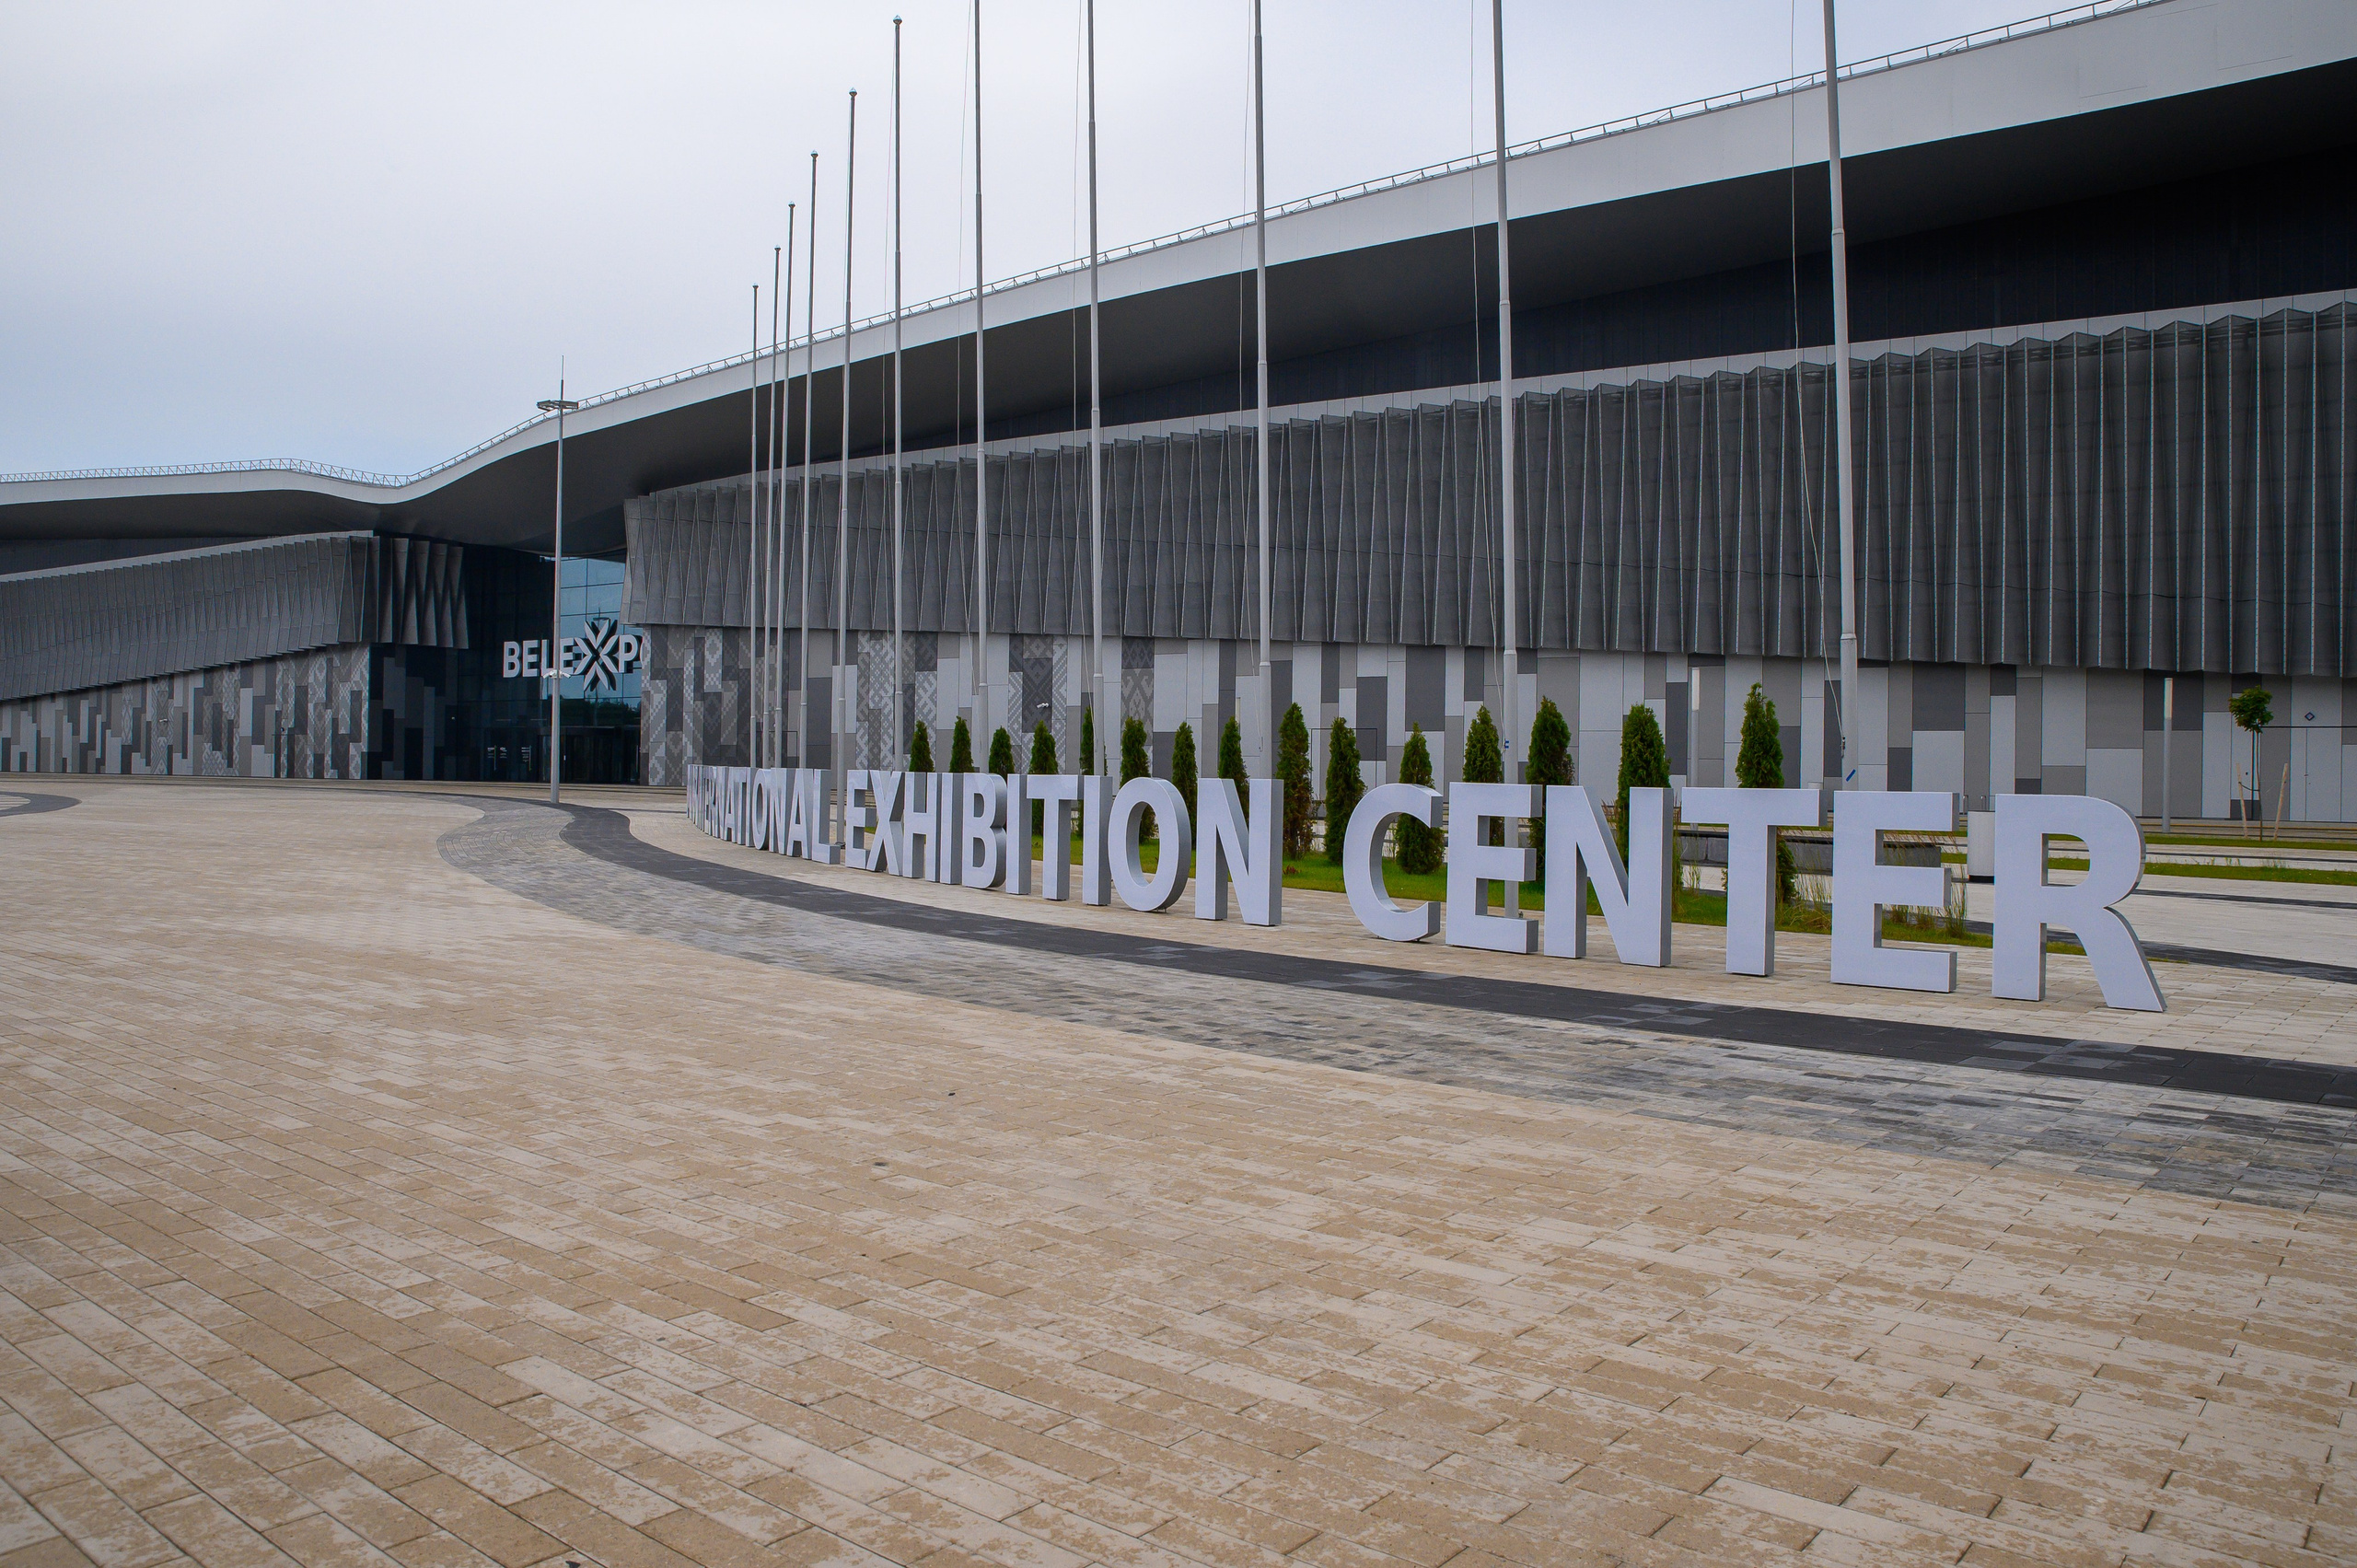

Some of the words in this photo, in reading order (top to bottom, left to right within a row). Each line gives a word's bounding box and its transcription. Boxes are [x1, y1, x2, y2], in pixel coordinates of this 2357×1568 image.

[503, 619, 642, 691] BELEXP
[845, 769, 1283, 926] EXHIBITION
[1343, 783, 2166, 1012] CENTER
